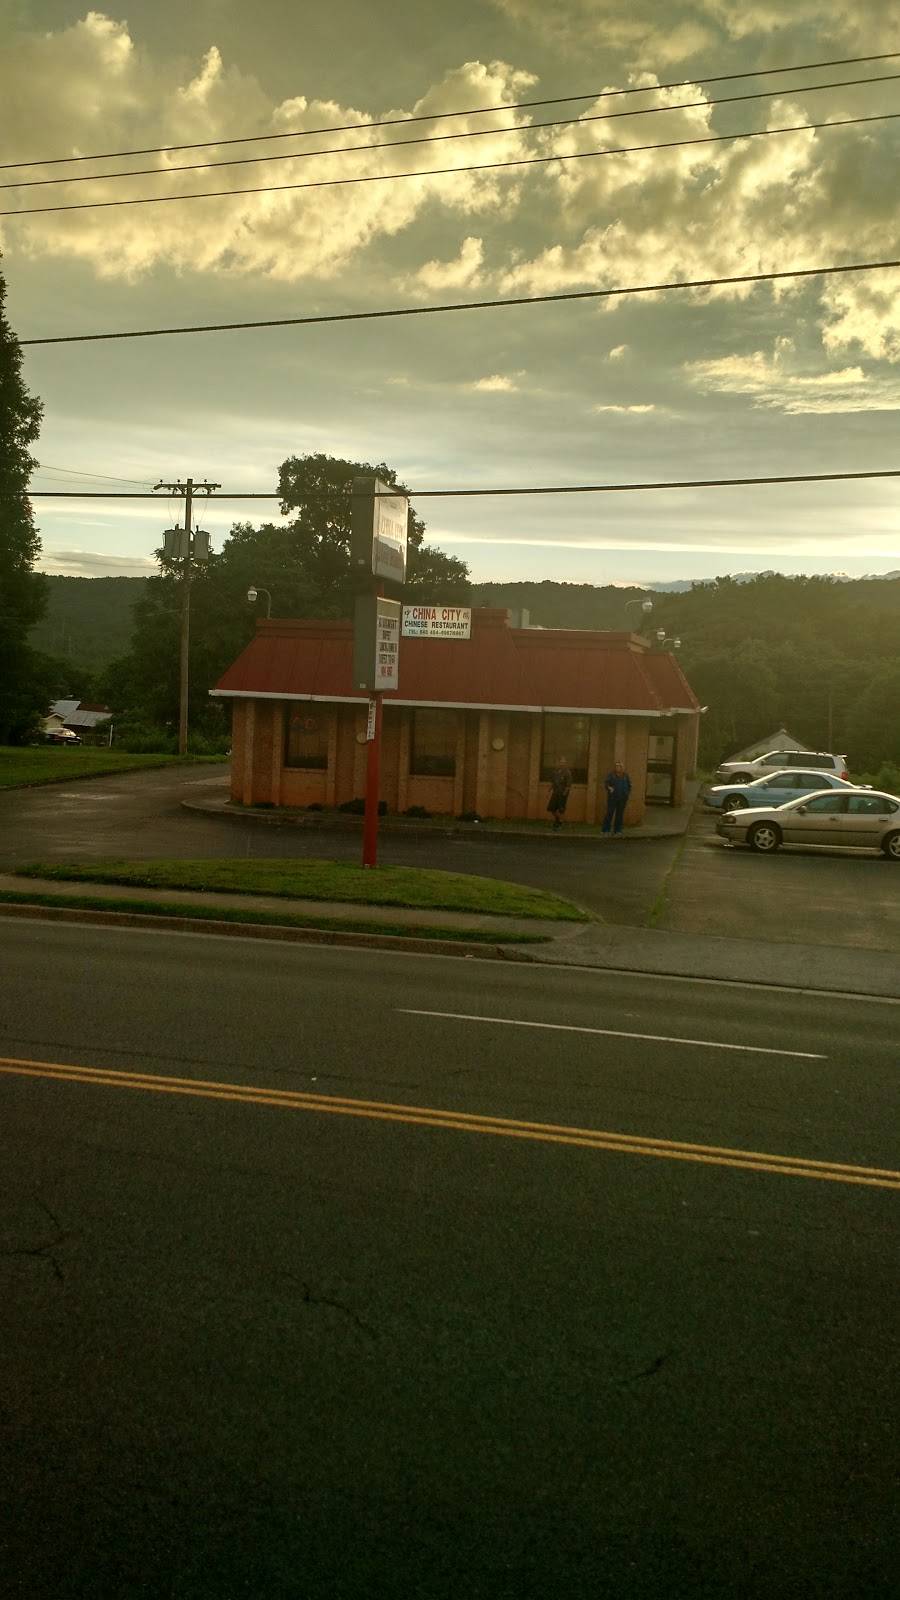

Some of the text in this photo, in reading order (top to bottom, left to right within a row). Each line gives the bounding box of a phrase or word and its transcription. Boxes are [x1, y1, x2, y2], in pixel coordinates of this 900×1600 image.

[412, 607, 437, 620] CHINA
[442, 608, 461, 621] CITY
[404, 620, 428, 628] CHINESE
[431, 621, 468, 630] RESTAURANT
